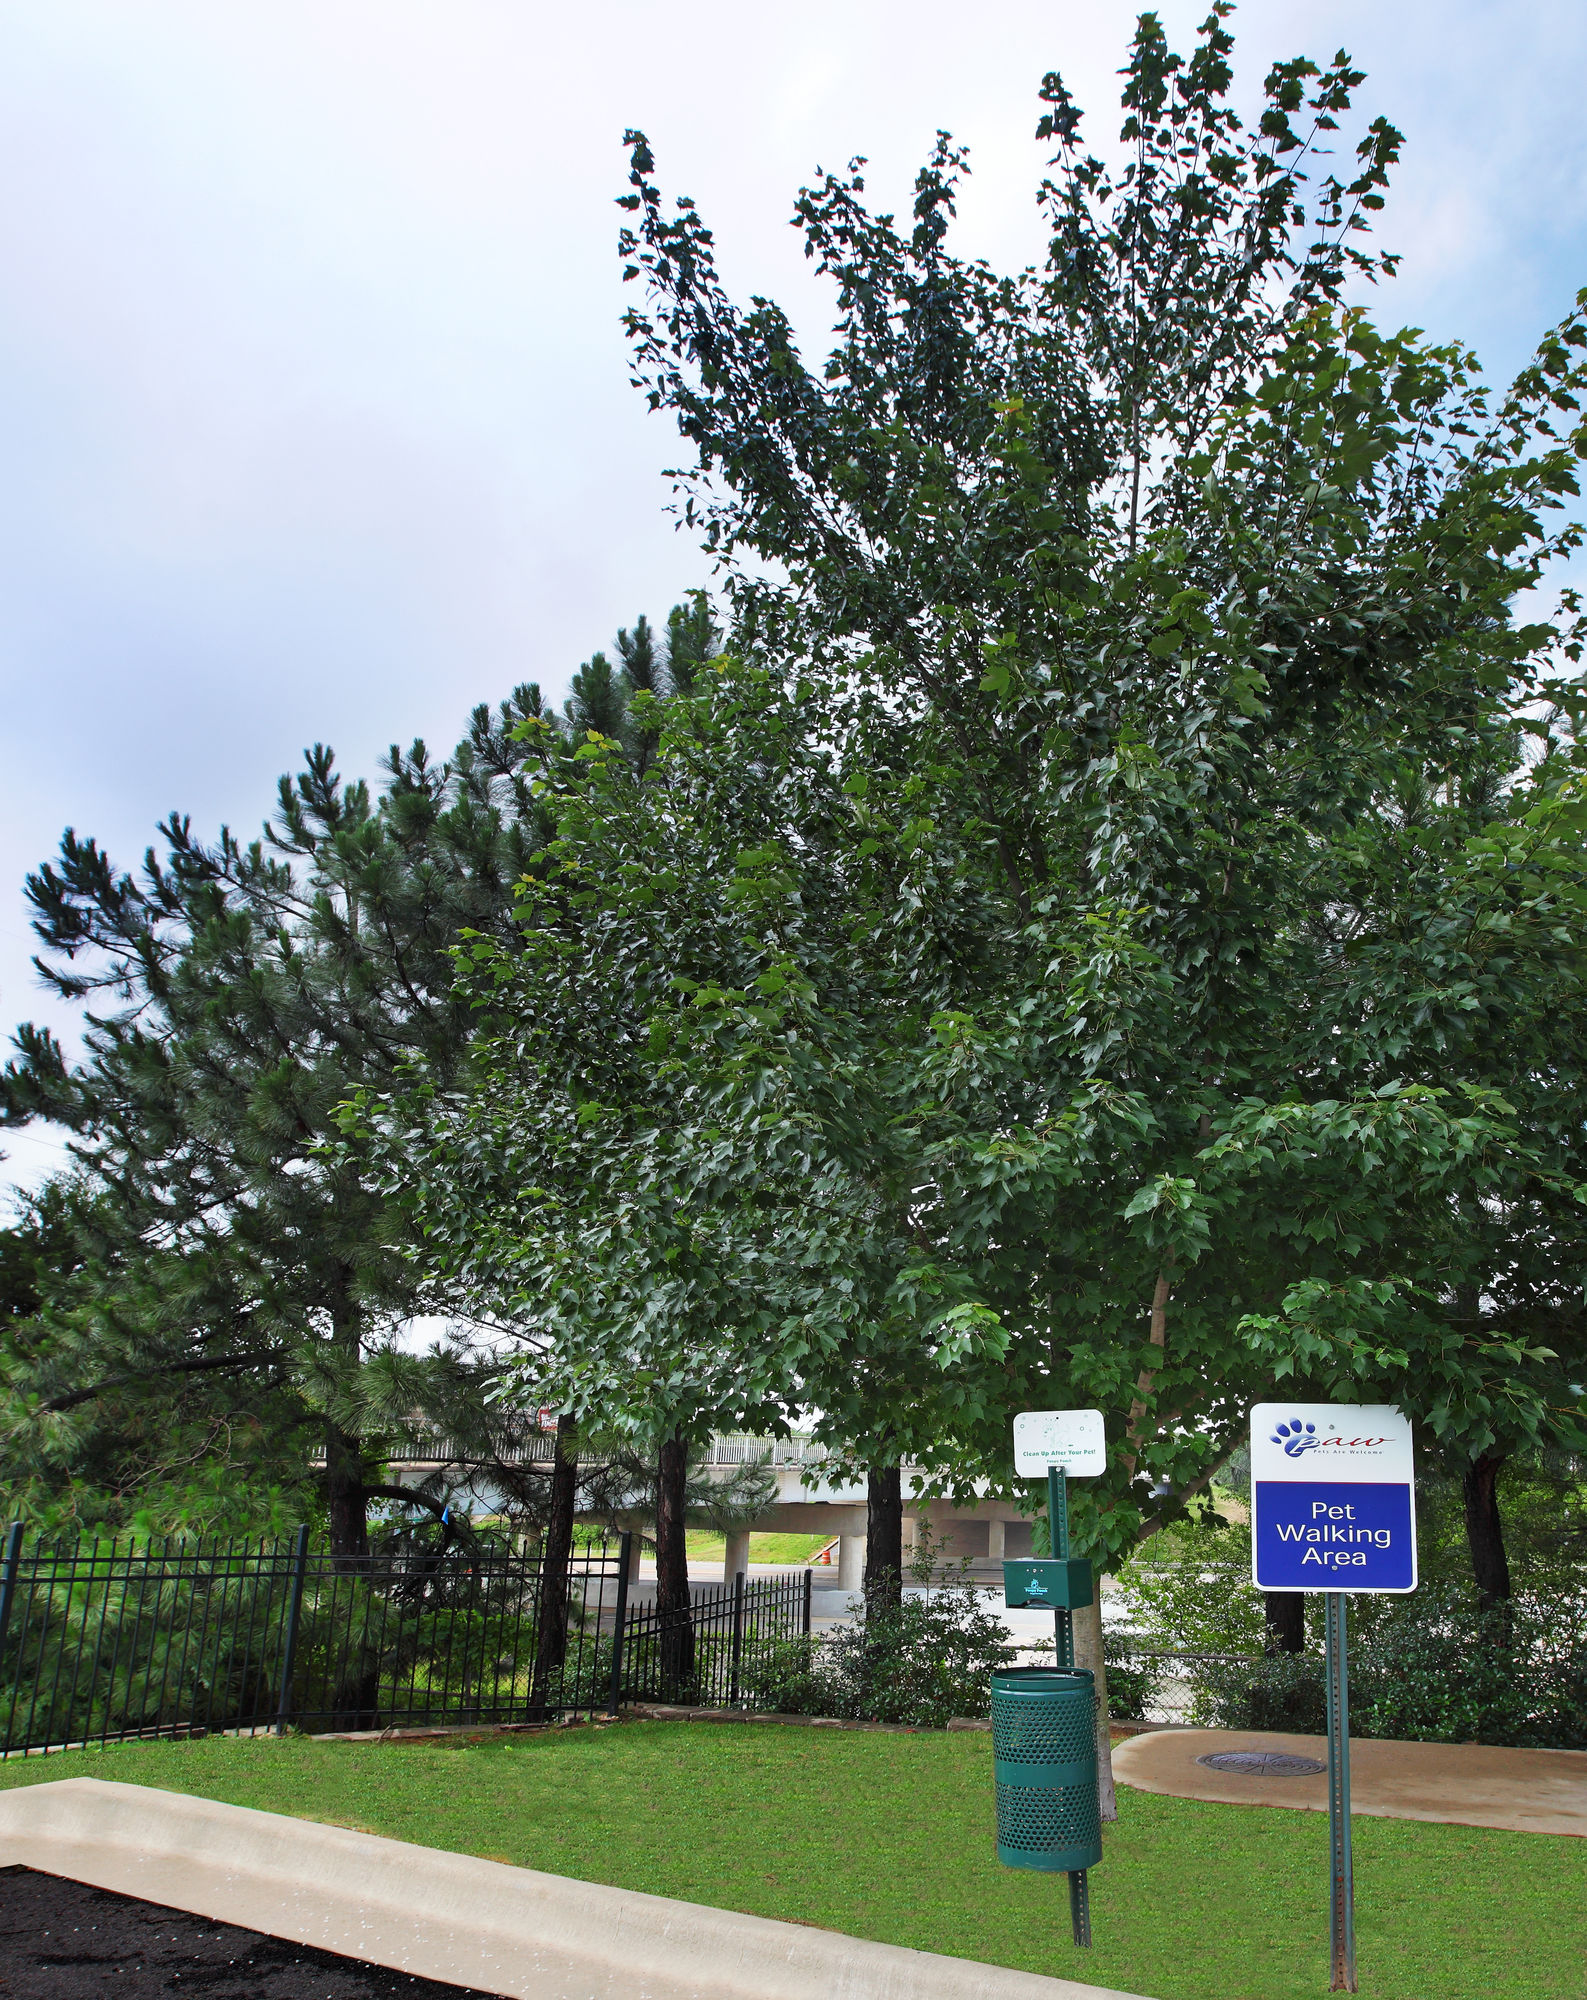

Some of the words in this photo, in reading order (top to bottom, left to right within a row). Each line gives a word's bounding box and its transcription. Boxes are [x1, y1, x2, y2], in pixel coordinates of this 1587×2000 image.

[1312, 1502, 1356, 1520] Pet
[1276, 1524, 1391, 1549] Walking
[1301, 1547, 1367, 1566] Area
